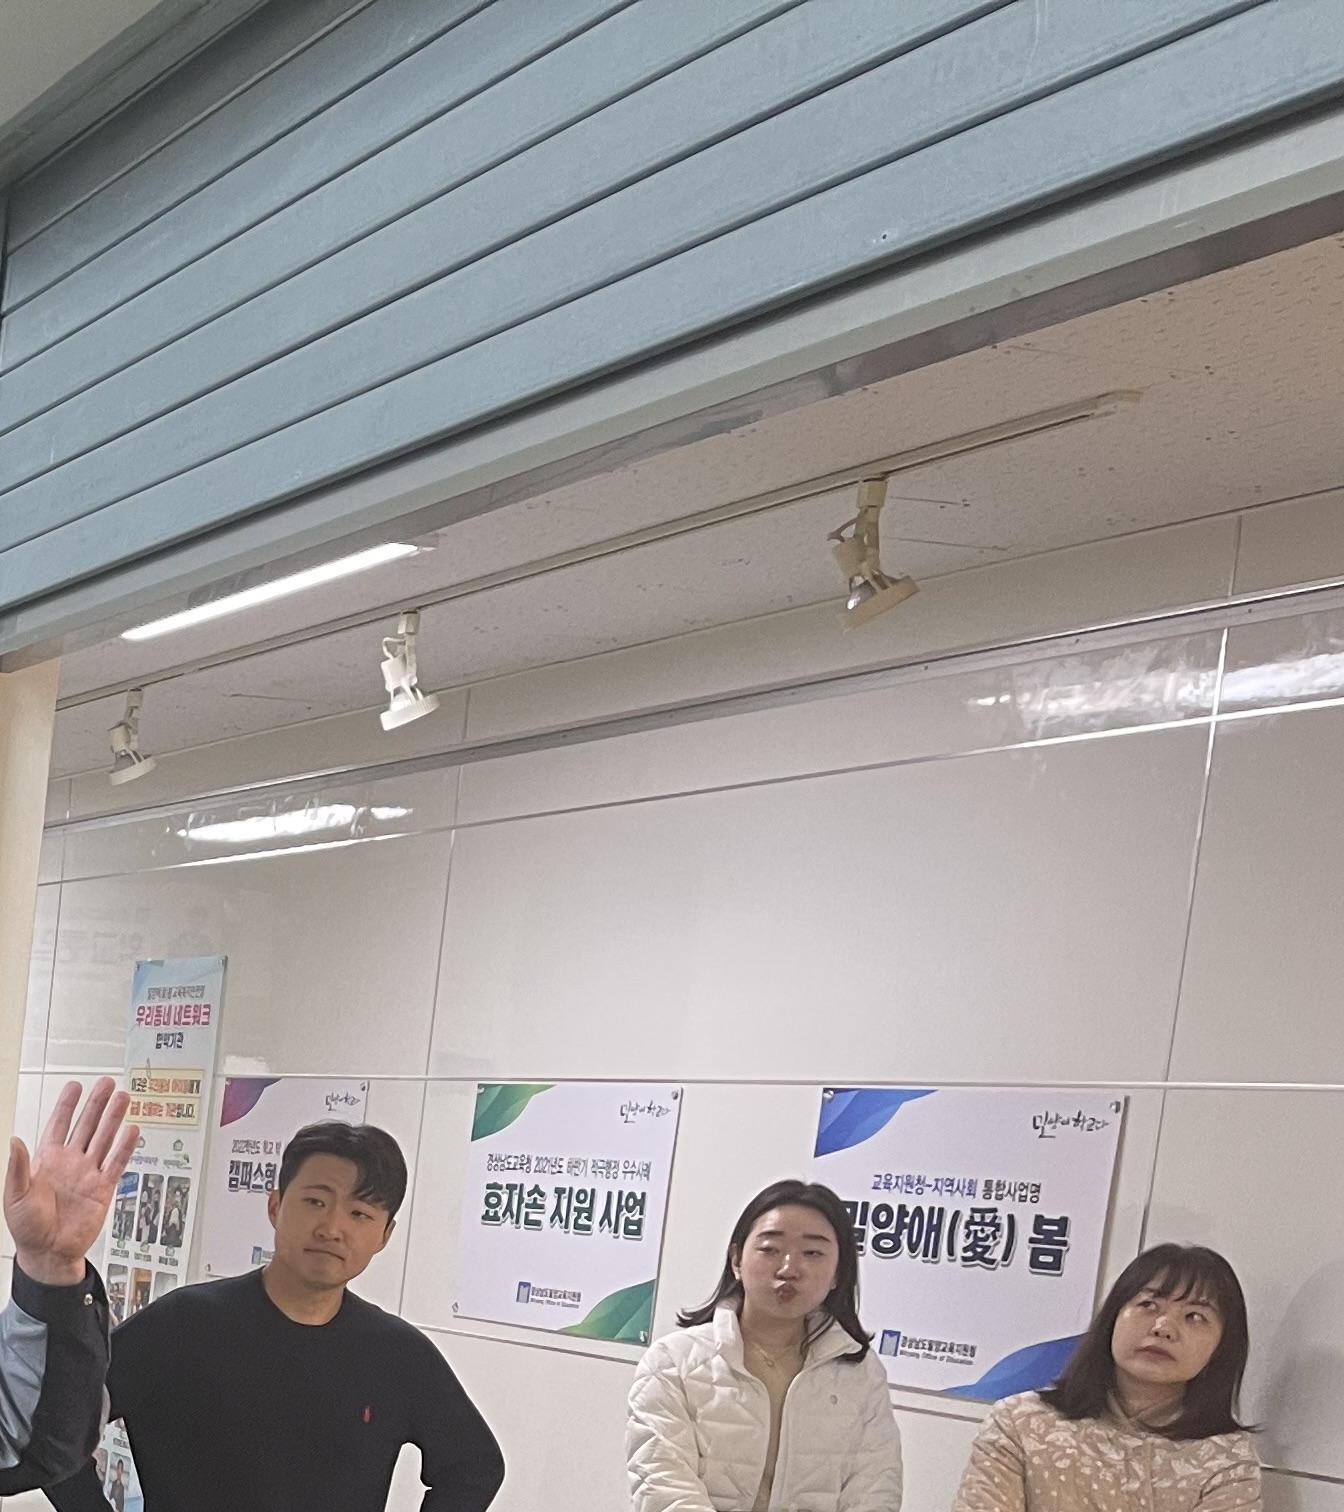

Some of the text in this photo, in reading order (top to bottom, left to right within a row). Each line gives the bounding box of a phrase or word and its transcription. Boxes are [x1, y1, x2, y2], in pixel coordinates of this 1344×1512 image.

[135, 1003, 211, 1028] 우리동네 네트워크
[228, 1160, 277, 1192] 캠퍼스형
[486, 1153, 532, 1174] 경상남도교육청
[622, 1159, 652, 1182] 우수사례
[871, 1172, 1042, 1204] 교육지원청-지역사회 통합사업명
[481, 1181, 647, 1239] 효자손 지원 사업
[1028, 1213, 1070, 1275] 봄
